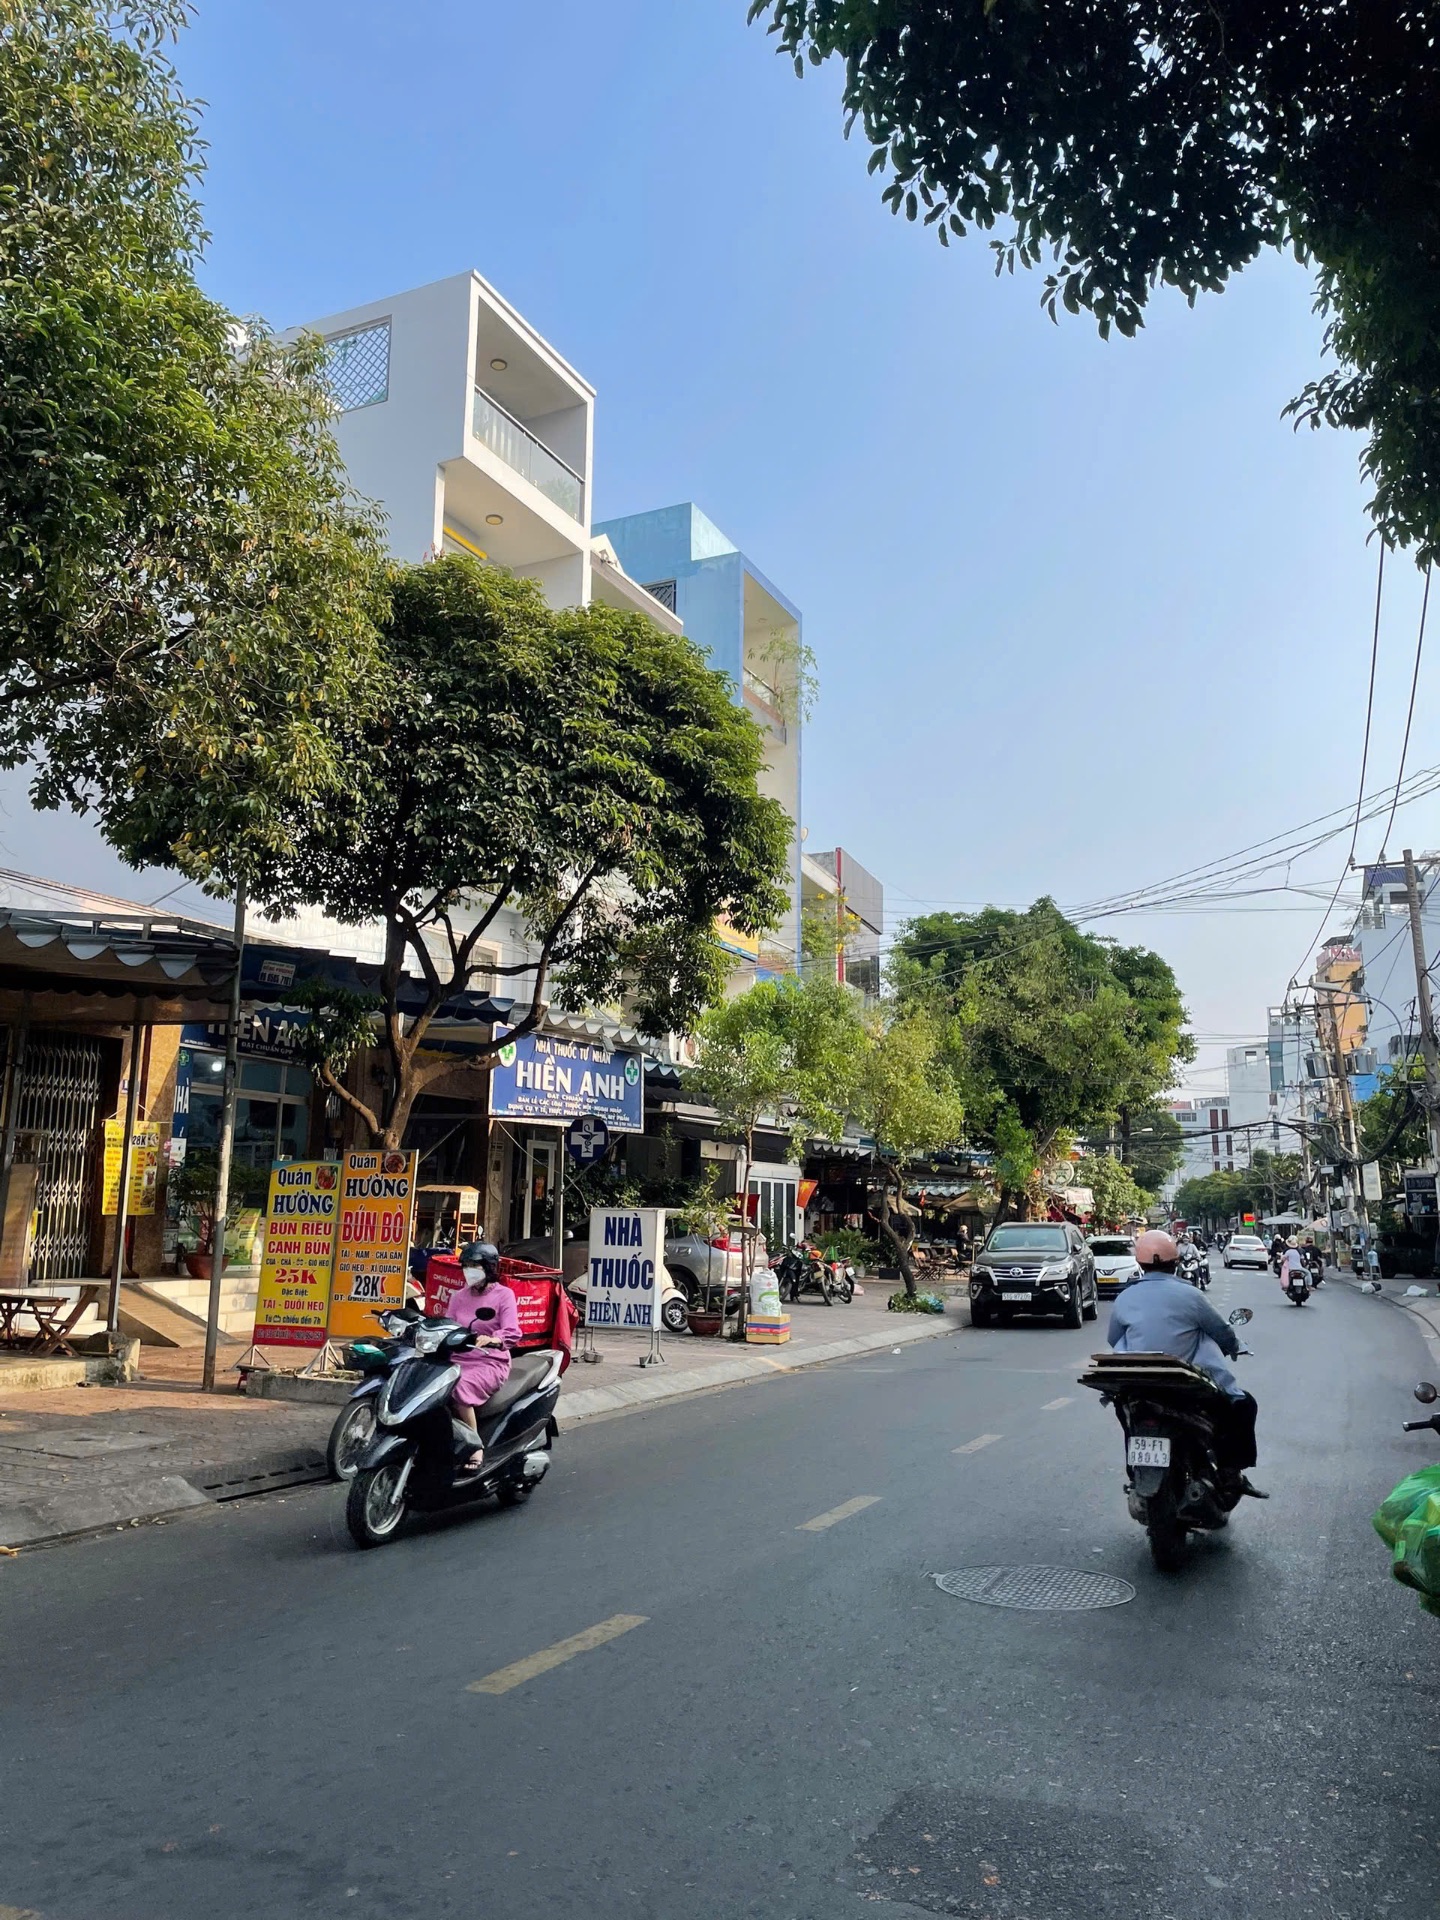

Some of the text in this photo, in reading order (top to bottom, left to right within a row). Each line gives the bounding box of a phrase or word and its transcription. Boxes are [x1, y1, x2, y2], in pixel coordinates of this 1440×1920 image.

[535, 1037, 551, 1054] NHÀ
[553, 1040, 577, 1060] THUỐC
[515, 1055, 625, 1101] HIỀN ANH
[132, 1135, 147, 1146] 28K
[350, 1154, 378, 1170] Quán
[278, 1168, 312, 1187] Quán
[345, 1173, 409, 1198] HƯỜNG
[272, 1190, 334, 1215] HƯỜNG
[269, 1219, 298, 1235] BÚN
[342, 1204, 405, 1244] BÚN BÒ
[604, 1212, 643, 1247] NHÀ
[267, 1239, 331, 1256] CANH BÚN
[274, 1268, 318, 1285] 25K
[590, 1251, 654, 1290] THUỐC
[353, 1274, 380, 1297] 28K
[307, 1301, 325, 1311] HEO
[588, 1290, 652, 1325] HIỀN ANH
